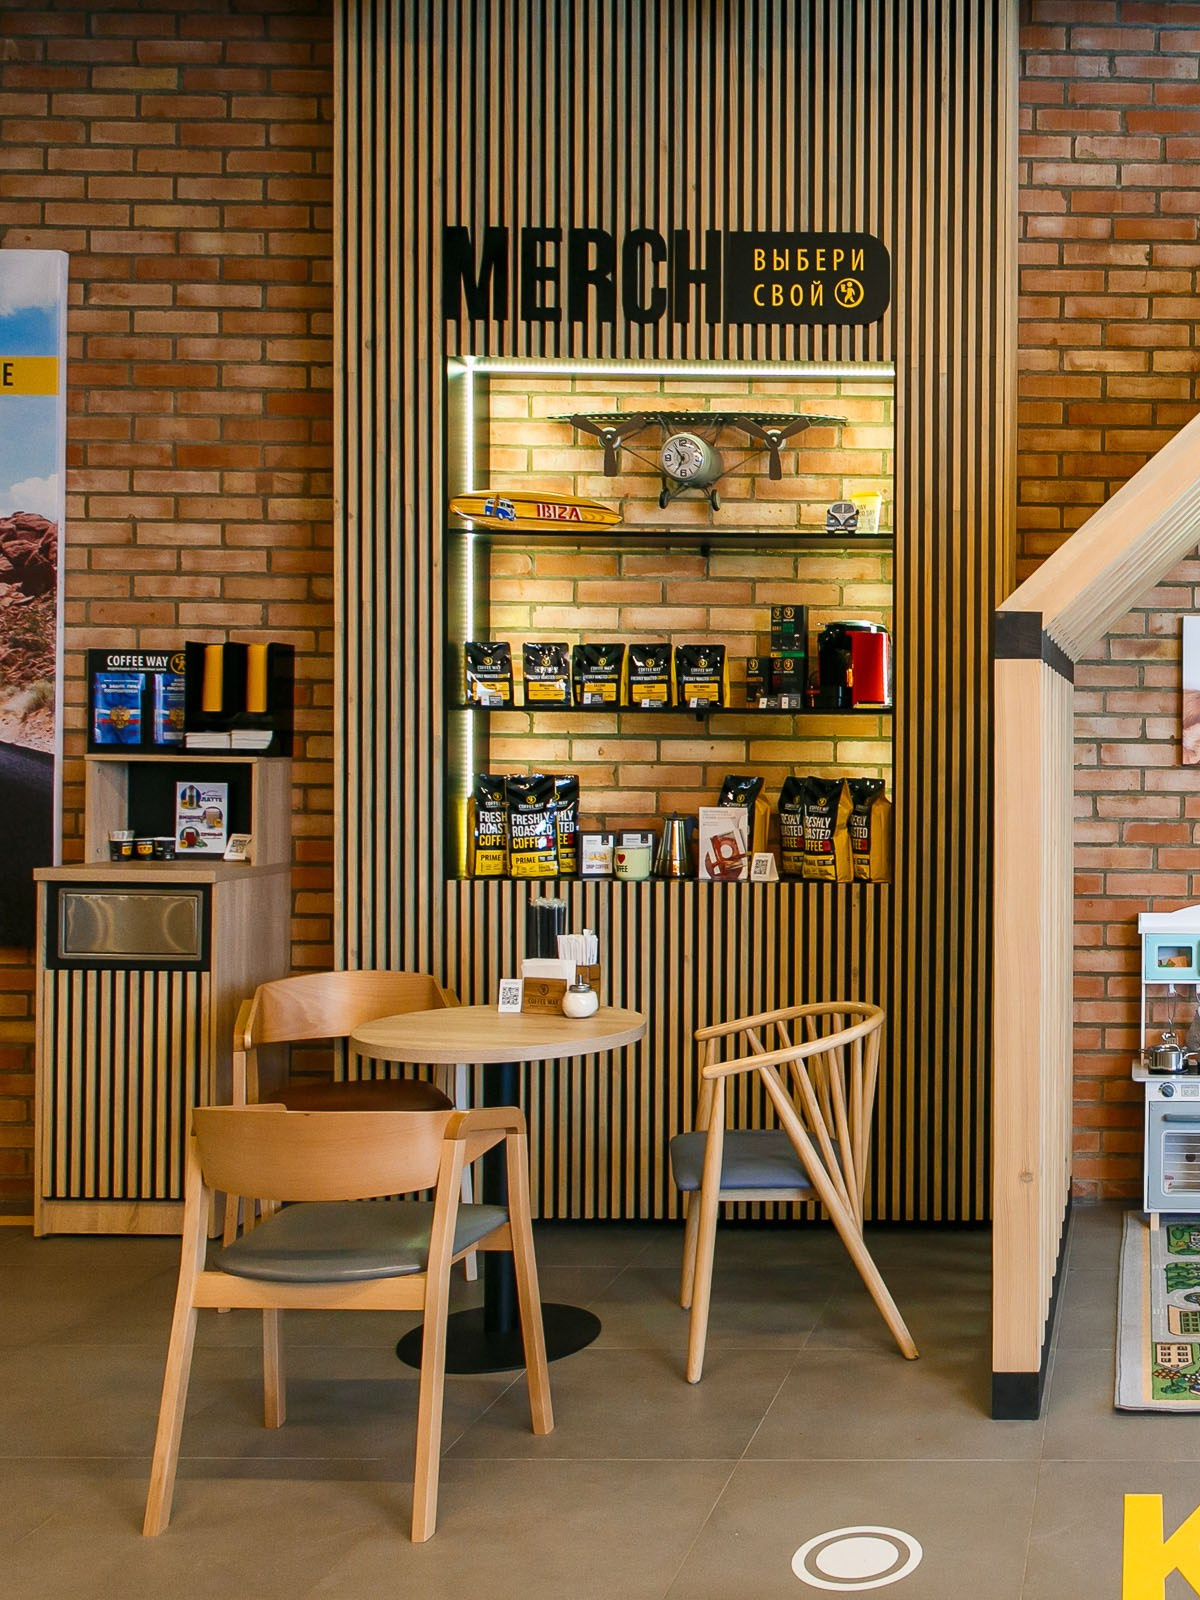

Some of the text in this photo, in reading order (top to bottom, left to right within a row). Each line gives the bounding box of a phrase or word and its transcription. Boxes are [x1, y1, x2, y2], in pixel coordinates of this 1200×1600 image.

[753, 248, 865, 272] ВЫБЕРИ
[443, 225, 722, 324] MERCH
[753, 280, 824, 307] СВОЙ
[680, 469, 687, 477] 6
[536, 503, 583, 521] IBIZA
[107, 655, 169, 667] COFFEE WAY
[511, 811, 550, 825] FRESHLY
[512, 824, 552, 837] ROASD
[513, 836, 547, 849] COFFE
